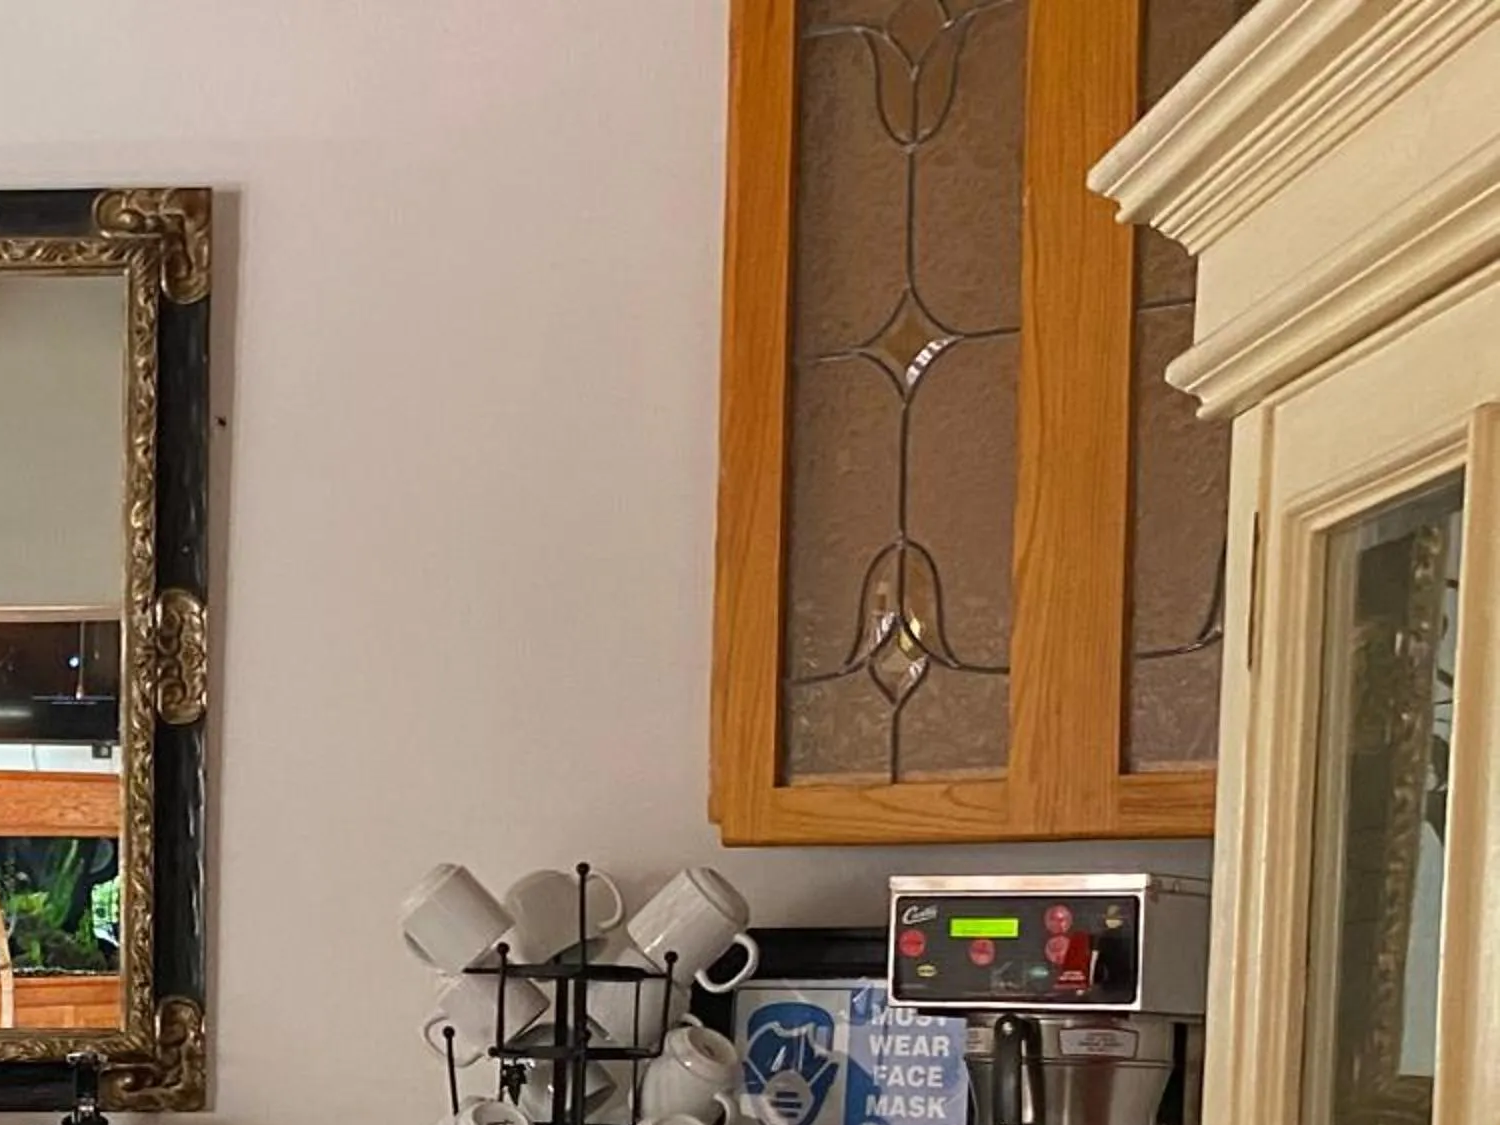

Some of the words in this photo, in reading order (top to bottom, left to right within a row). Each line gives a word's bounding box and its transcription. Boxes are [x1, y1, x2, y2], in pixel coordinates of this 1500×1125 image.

[869, 1034, 950, 1057] WEAR
[873, 1065, 944, 1088] FACE
[865, 1095, 946, 1119] MASK
